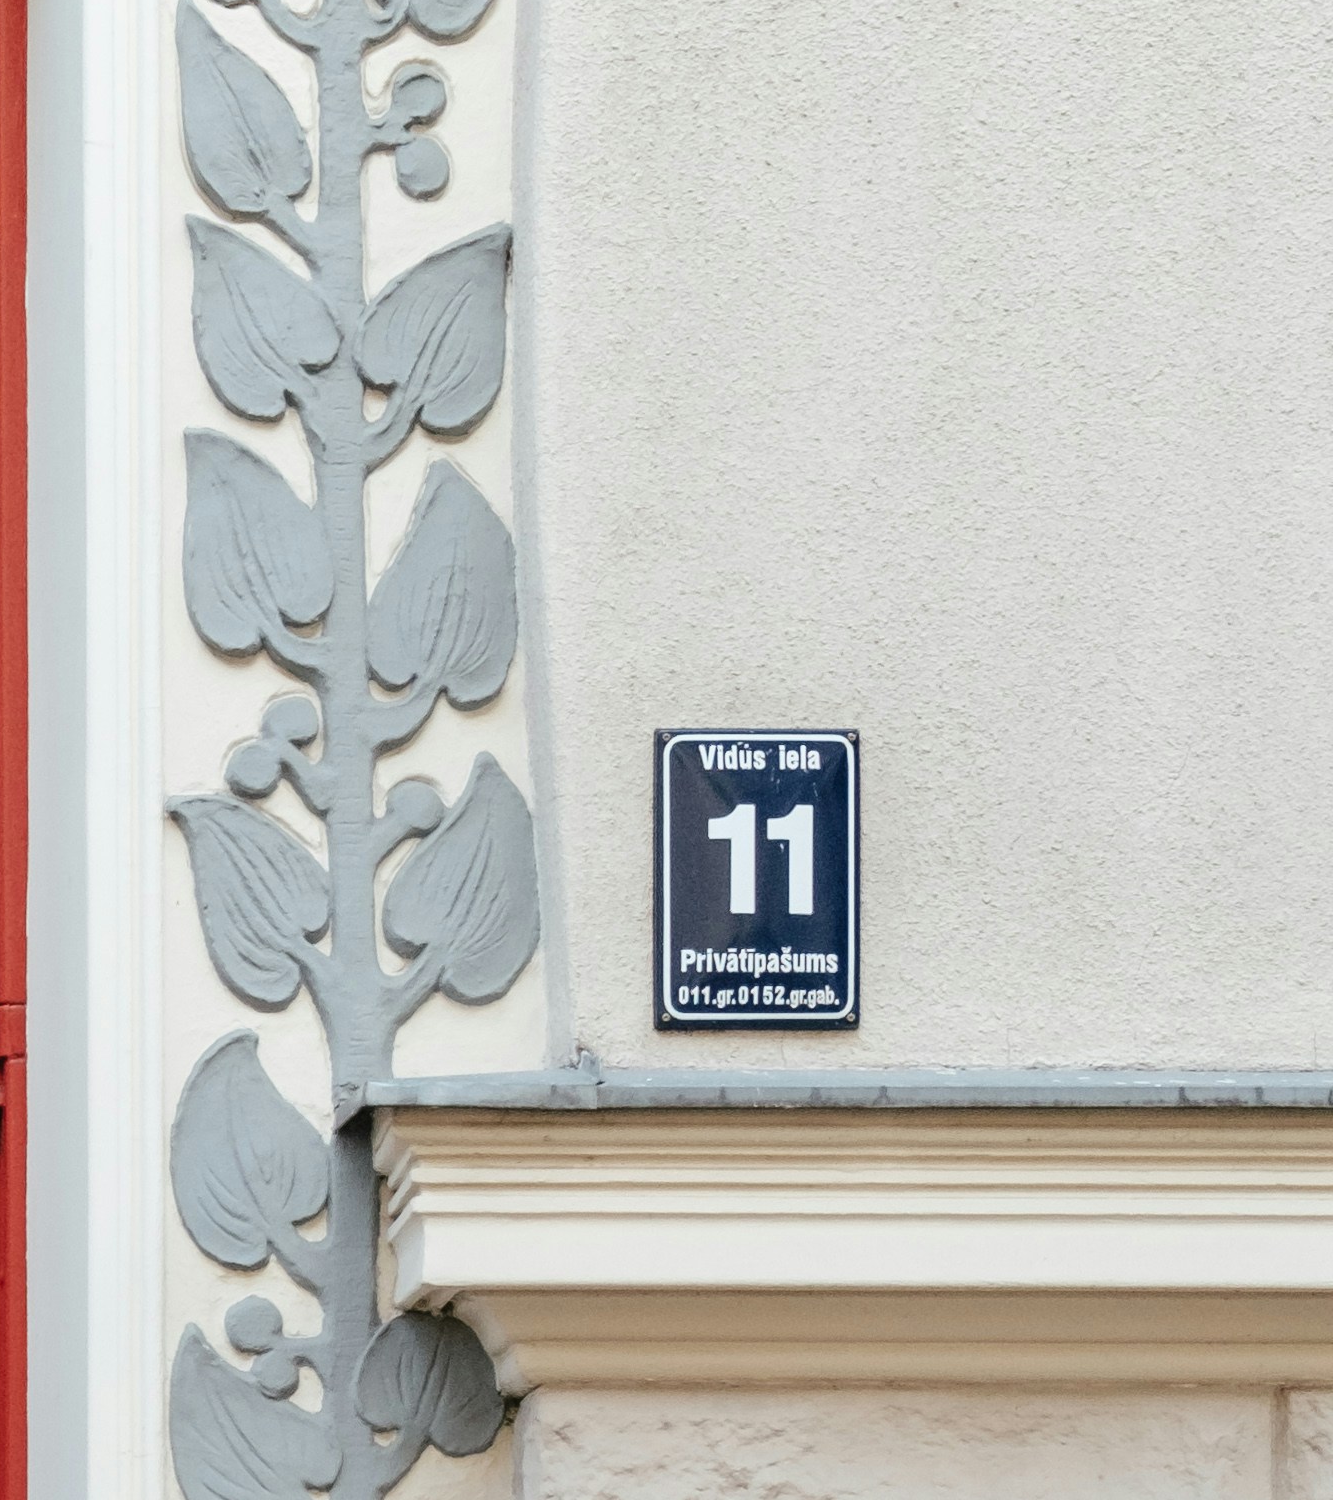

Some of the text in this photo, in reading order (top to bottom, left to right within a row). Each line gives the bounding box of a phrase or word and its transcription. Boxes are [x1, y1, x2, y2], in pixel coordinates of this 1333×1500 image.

[778, 744, 821, 771] iela
[707, 803, 814, 916] 11
[680, 946, 839, 978] Privātīpašums
